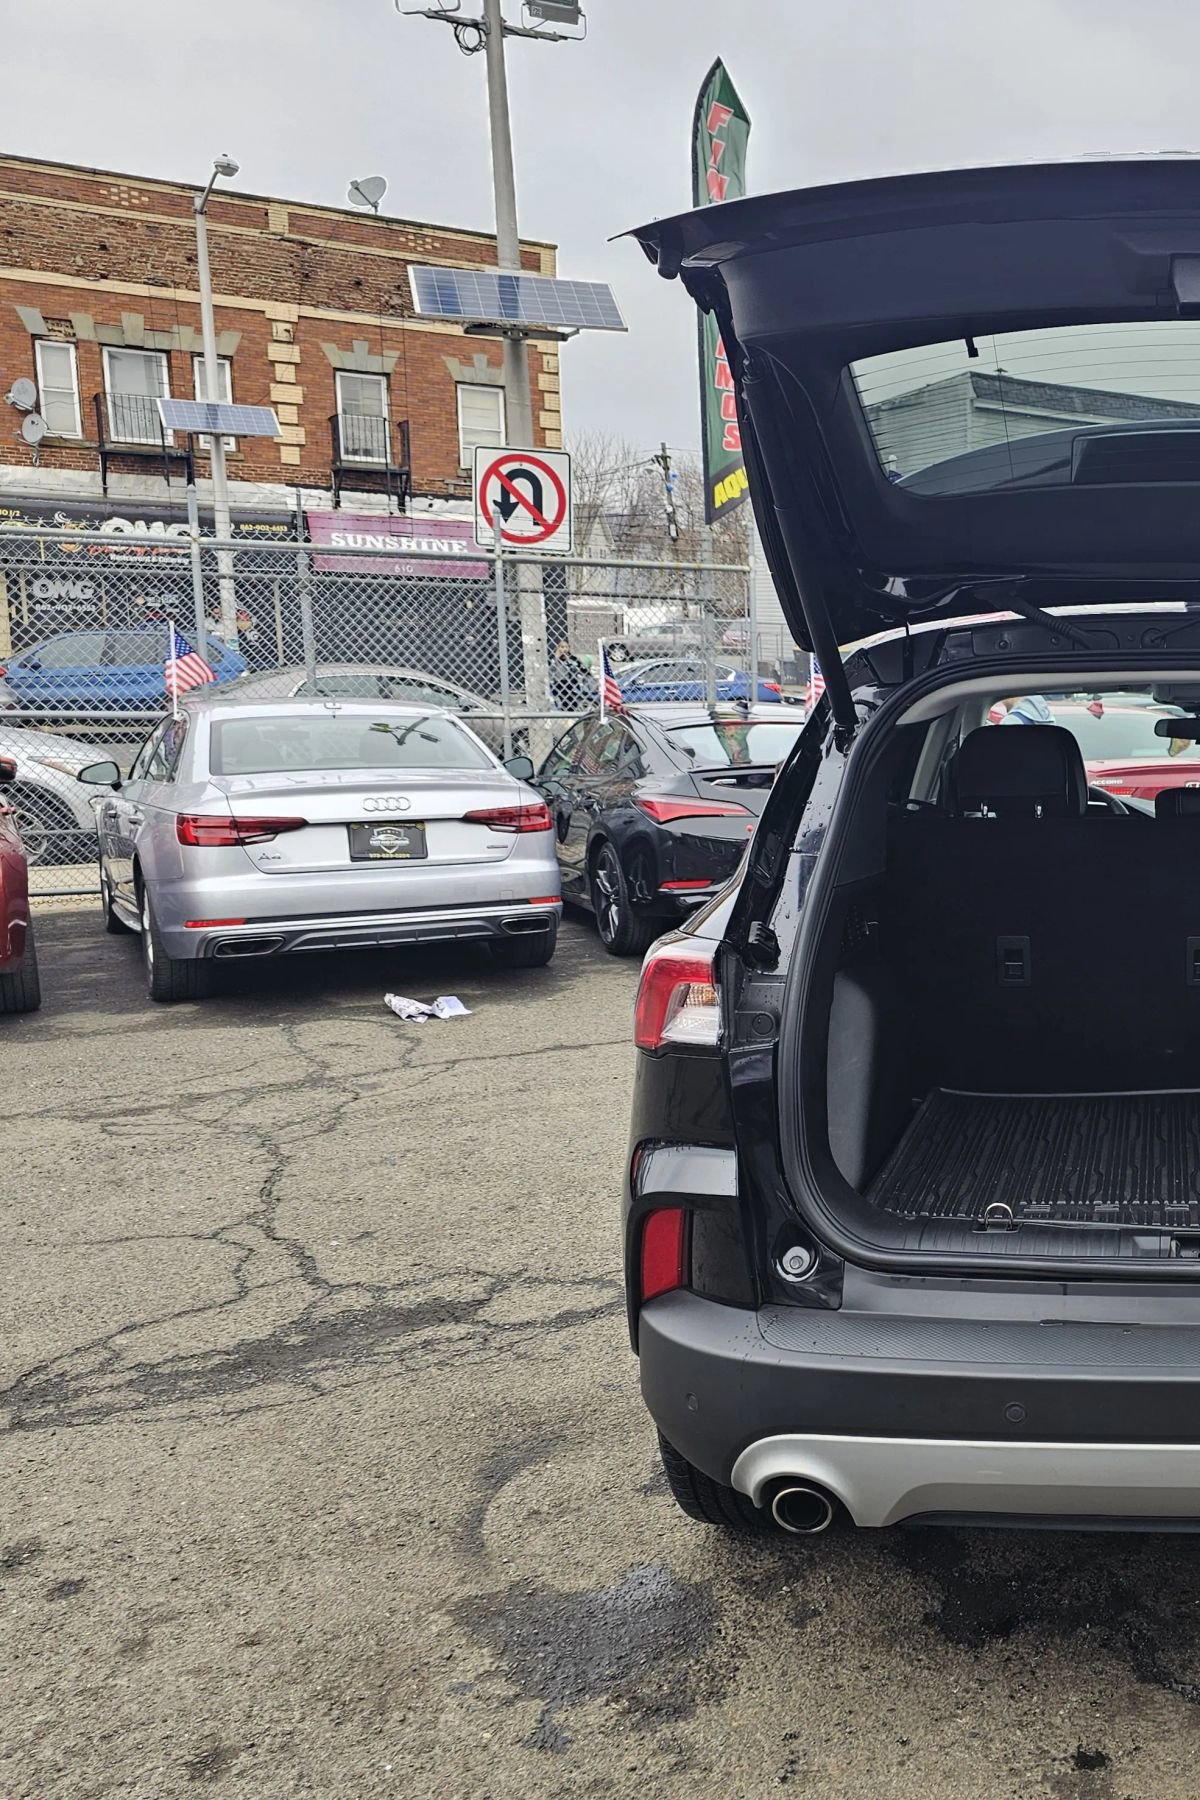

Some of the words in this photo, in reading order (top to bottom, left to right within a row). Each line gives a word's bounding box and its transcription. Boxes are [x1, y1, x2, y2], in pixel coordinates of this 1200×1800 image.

[714, 466, 748, 509] AQU
[331, 532, 469, 553] SUNSHINE
[395, 564, 414, 573] 610
[33, 580, 95, 599] OMG
[257, 852, 281, 861] A4
